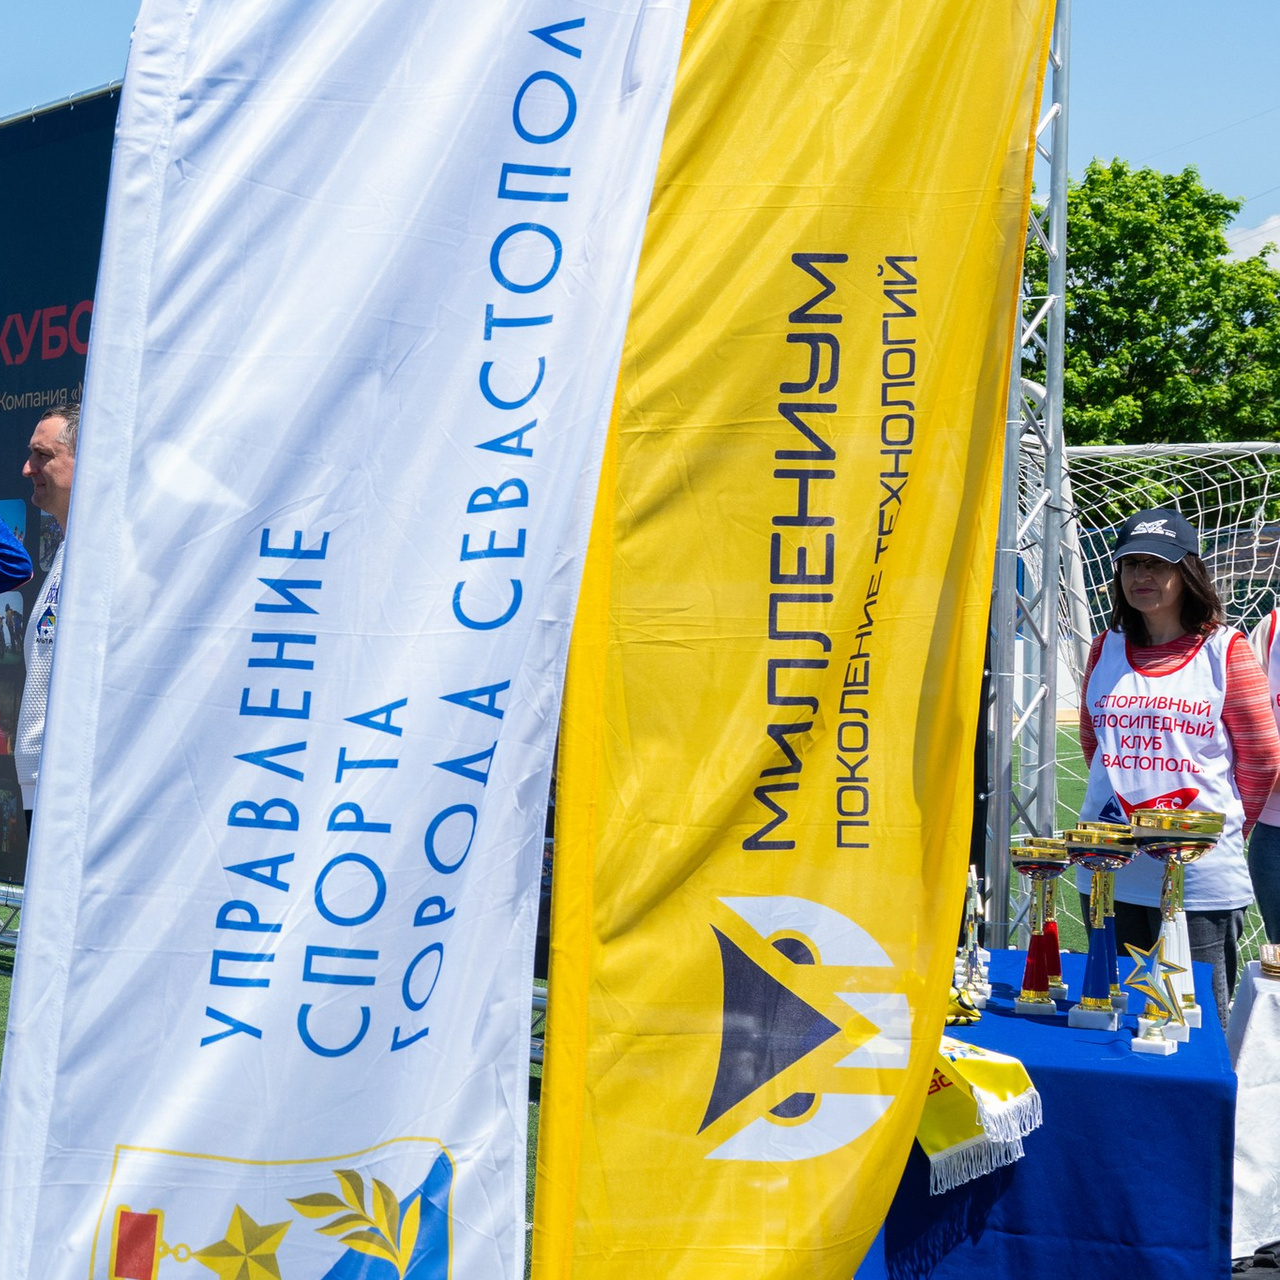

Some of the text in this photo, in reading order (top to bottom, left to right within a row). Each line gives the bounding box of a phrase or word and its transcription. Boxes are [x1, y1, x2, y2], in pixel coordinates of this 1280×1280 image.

[741, 252, 848, 852] МИЛЛЕНИУМ
[836, 255, 918, 849] ПОКОЛЕНИЕ ТЕХНОЛОГИЙ
[1092, 713, 1215, 739] ЕЛОСИПЕДНЫЙ
[200, 527, 330, 1048] УПРАВЛЕНИЕ
[297, 696, 408, 1058] СПОРТА
[390, 678, 511, 1051] ГОРОДА
[1121, 734, 1163, 751] КЛУБ
